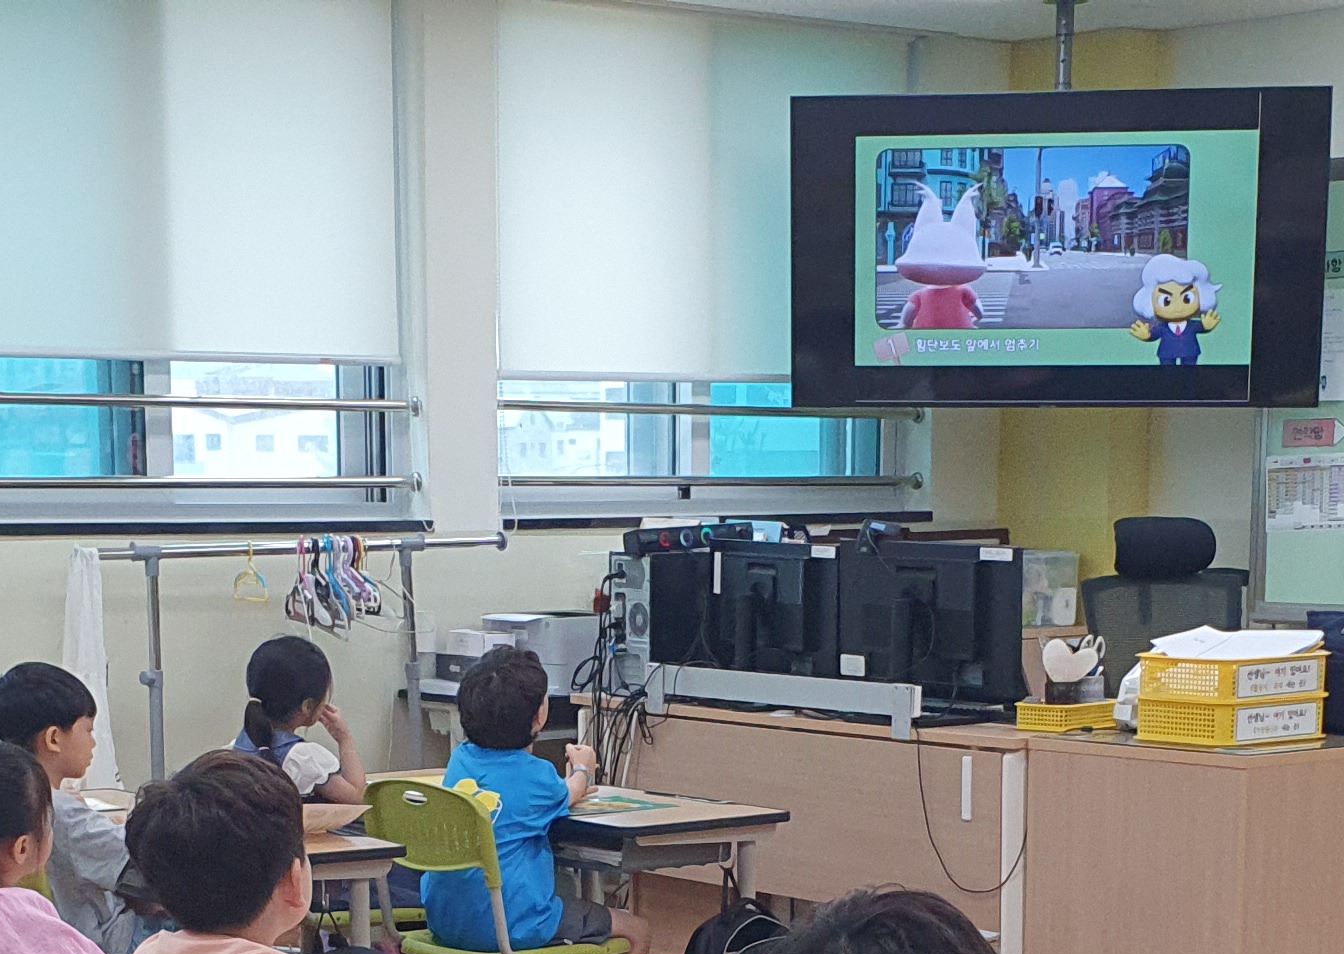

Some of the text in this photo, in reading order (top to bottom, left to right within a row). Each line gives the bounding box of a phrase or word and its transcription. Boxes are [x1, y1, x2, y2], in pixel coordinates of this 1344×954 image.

[916, 338, 1040, 353] 횡단보도 앞에서 멈추기
